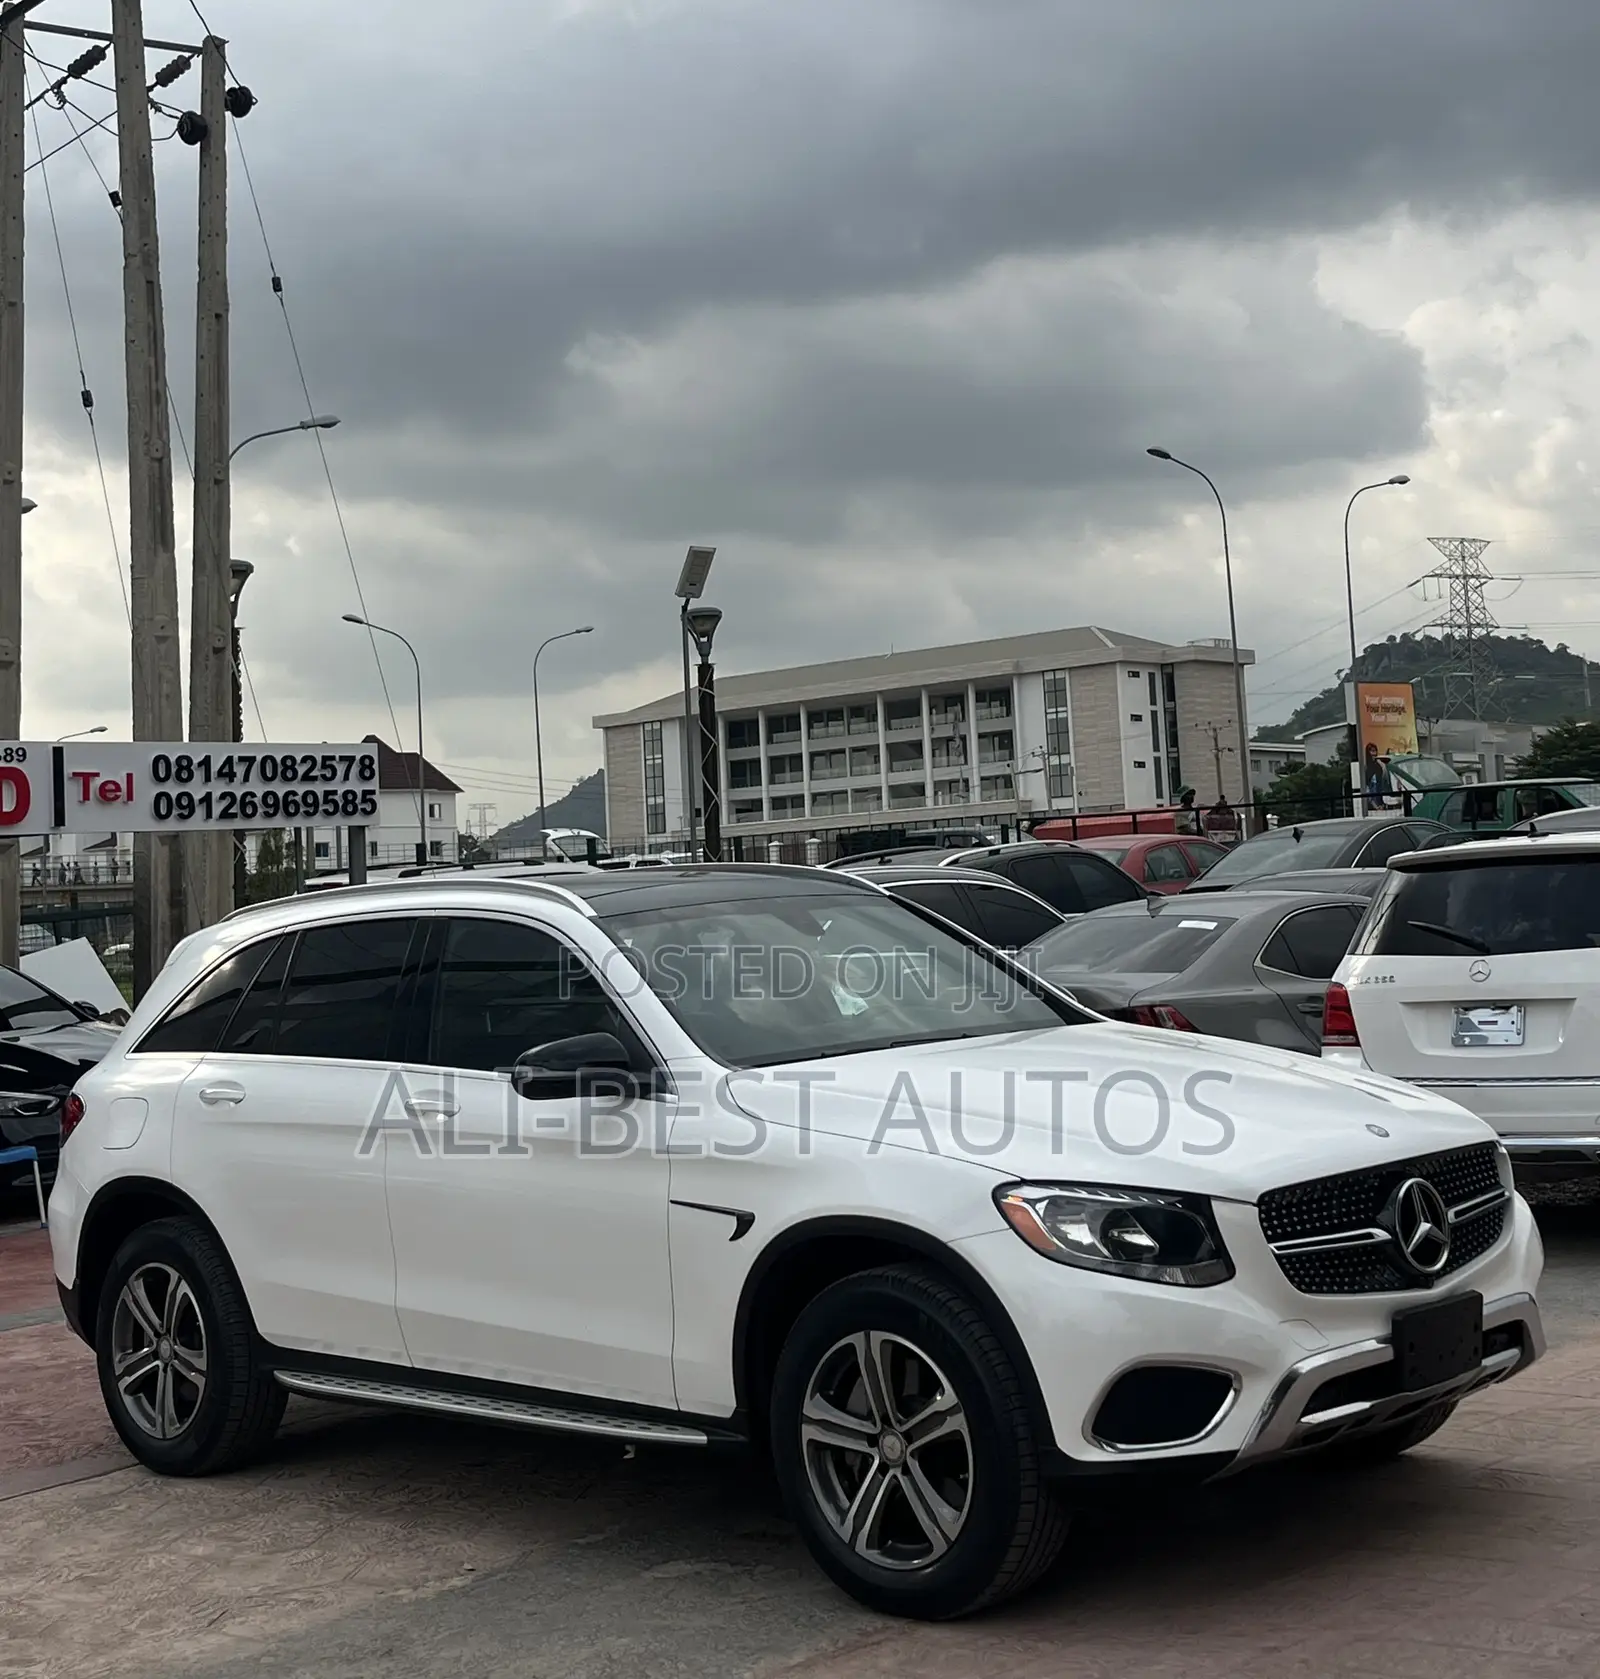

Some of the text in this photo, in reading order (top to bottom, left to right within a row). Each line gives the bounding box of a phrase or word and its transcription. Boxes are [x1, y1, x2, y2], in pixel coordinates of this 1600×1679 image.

[1365, 703, 1379, 713] Your
[0, 747, 27, 763] 89
[151, 754, 376, 783] 08147082578
[72, 771, 135, 803] Tel
[153, 789, 378, 820] 09126969585
